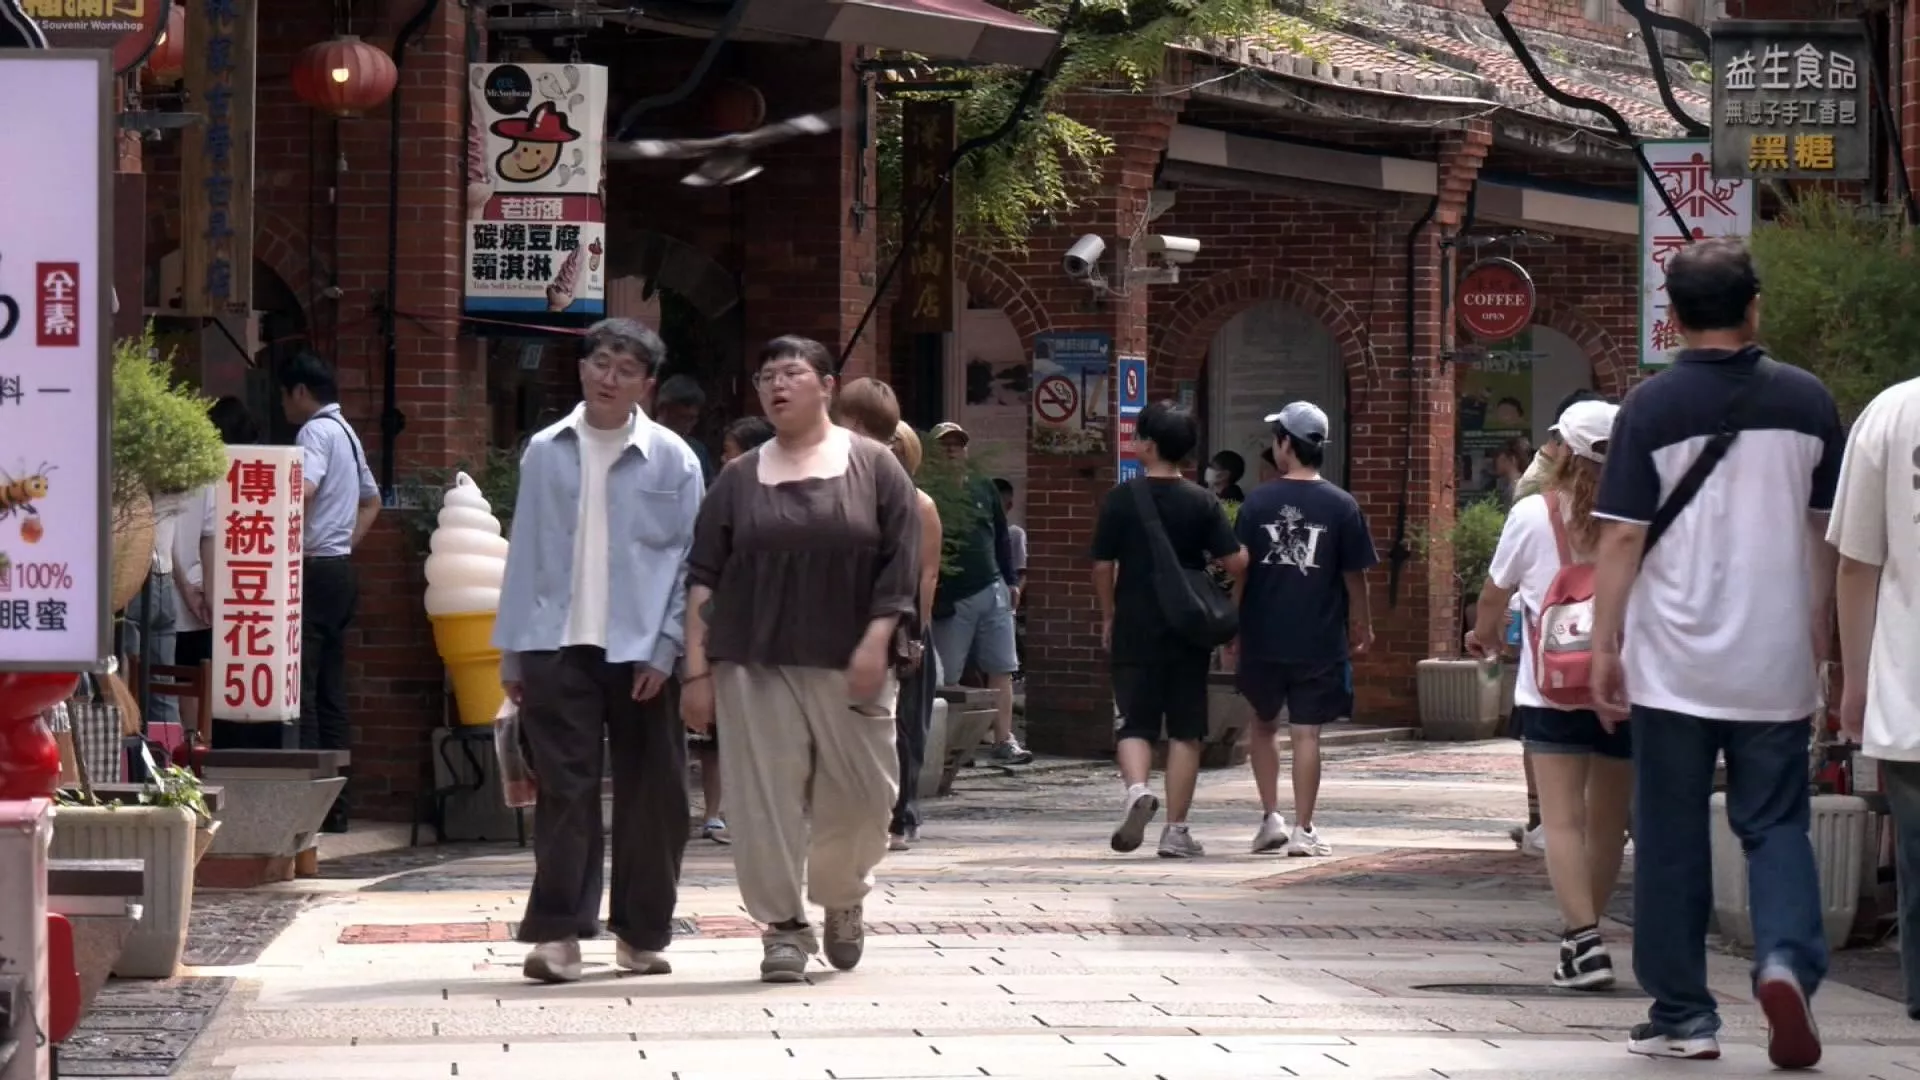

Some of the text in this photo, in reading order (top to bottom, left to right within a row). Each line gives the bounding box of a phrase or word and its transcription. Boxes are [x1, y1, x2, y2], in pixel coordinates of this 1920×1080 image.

[42, 20, 87, 31] Souvenir
[91, 20, 144, 31] Workshop
[1725, 42, 1857, 91] 益生食品
[1748, 133, 1837, 171] 黑糖
[500, 197, 563, 219] 老街頭
[473, 223, 580, 252] 碳燒豆腐
[472, 252, 552, 281] 霜淇淋
[43, 269, 75, 336] 全素
[1463, 293, 1526, 307] COFFEE
[224, 458, 277, 657] 傳統豆花
[286, 459, 303, 656] 傳統豆花
[224, 662, 274, 708] 50
[285, 661, 299, 707] 50
